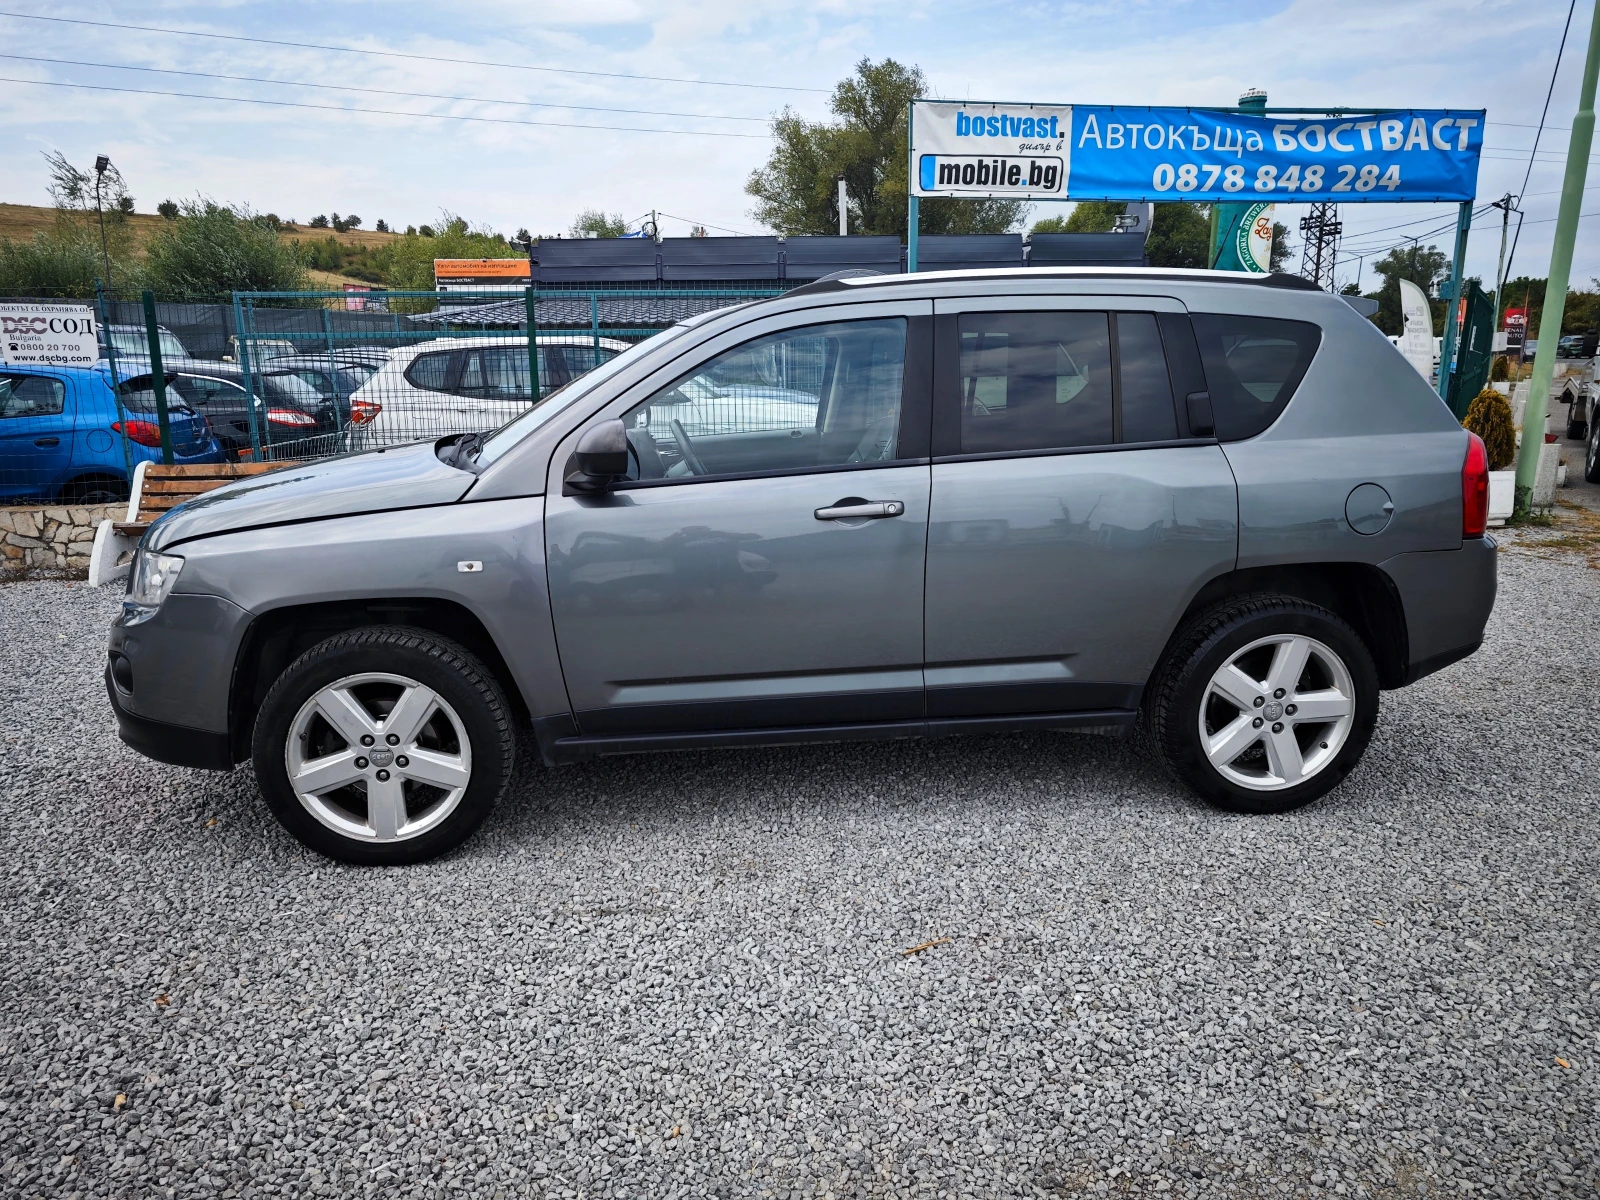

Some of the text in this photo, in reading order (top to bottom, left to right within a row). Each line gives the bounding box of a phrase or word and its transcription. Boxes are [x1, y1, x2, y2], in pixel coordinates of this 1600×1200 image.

[956, 112, 1065, 139] bostvast.
[1078, 113, 1478, 159] Автокъща БОСТВАСТ
[1018, 143, 1052, 154] дилър
[939, 159, 1058, 190] mobile.bg
[1152, 163, 1402, 193] 0878 848 284
[1243, 203, 1268, 230] BREWER
[1, 317, 48, 335] DSC
[49, 318, 95, 337] СОД
[9, 334, 42, 342] Bulgaria
[61, 344, 81, 352] 700
[13, 354, 92, 364] www.dscbg.com
